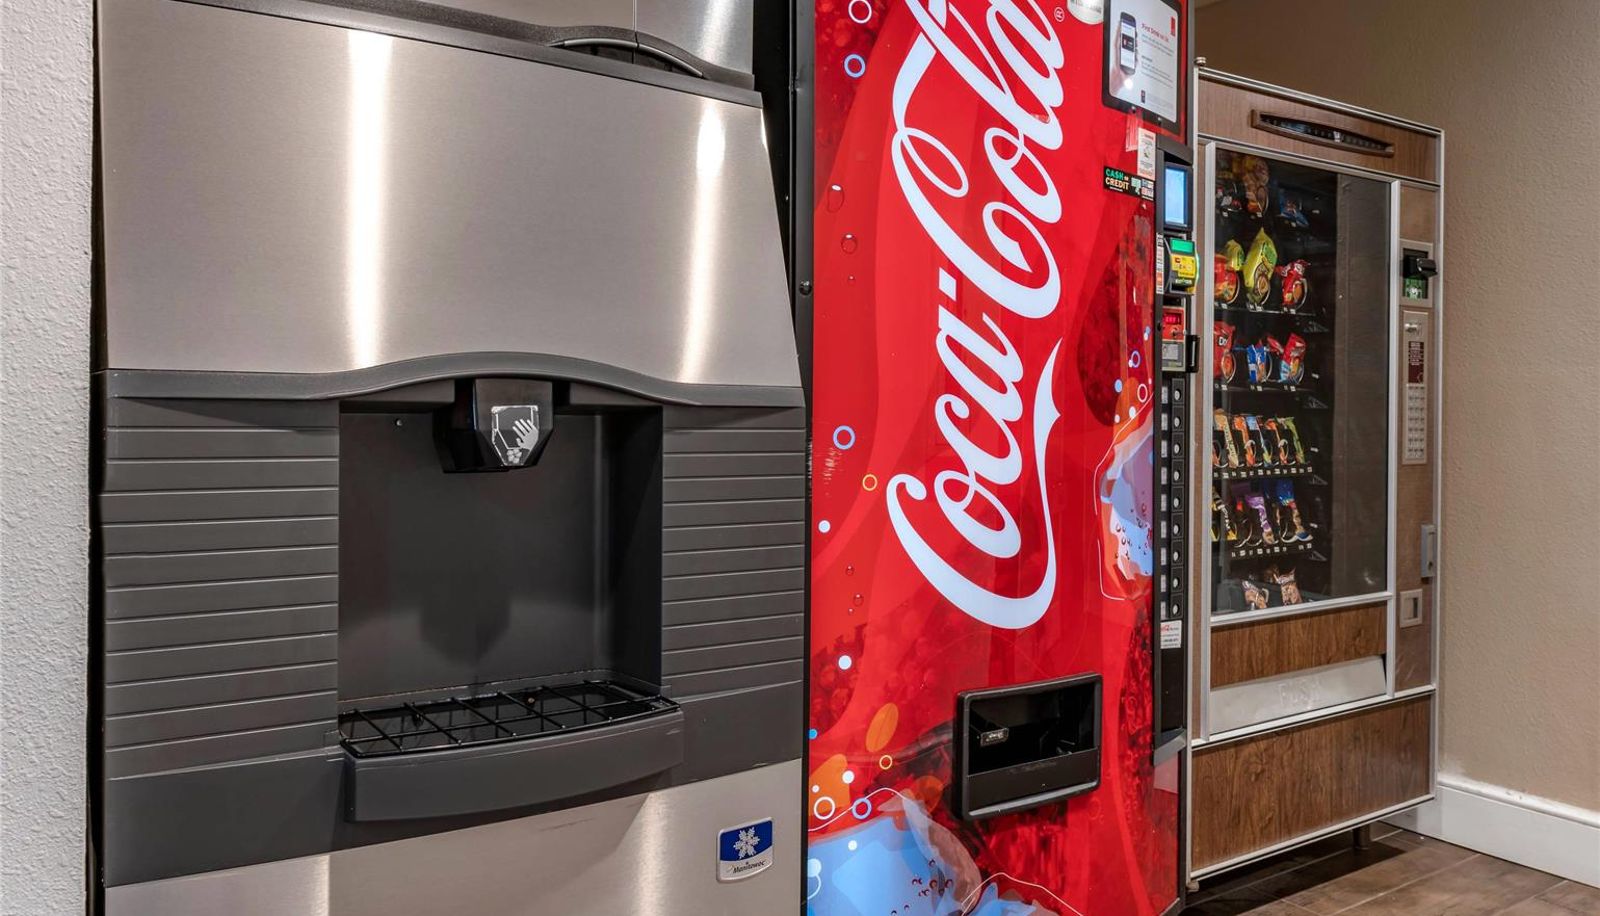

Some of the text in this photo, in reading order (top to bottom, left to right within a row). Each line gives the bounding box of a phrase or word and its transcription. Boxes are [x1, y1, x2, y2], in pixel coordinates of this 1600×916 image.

[1105, 168, 1124, 181] CASH
[1105, 177, 1129, 190] CREDIT
[886, 0, 1066, 629] Coca-Cola
